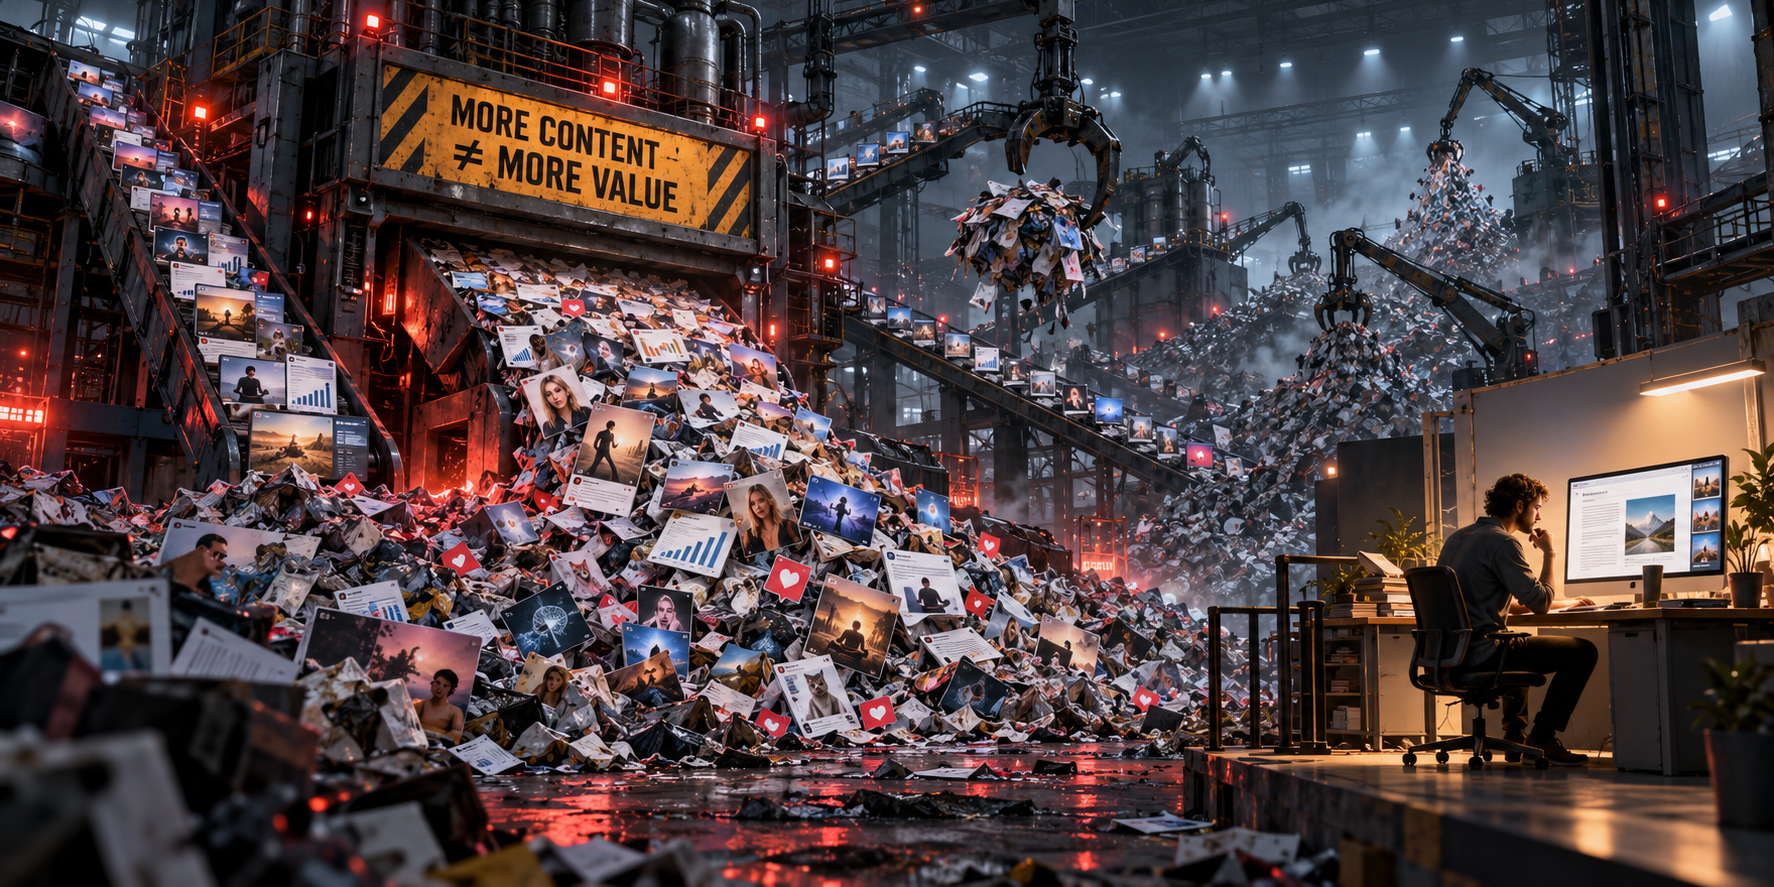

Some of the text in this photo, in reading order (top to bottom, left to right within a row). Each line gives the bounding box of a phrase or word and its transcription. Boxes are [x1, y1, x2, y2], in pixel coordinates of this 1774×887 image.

[450, 93, 660, 170] MORE CONTENT
[497, 145, 582, 195] MORE
[591, 165, 678, 214] VALUE
